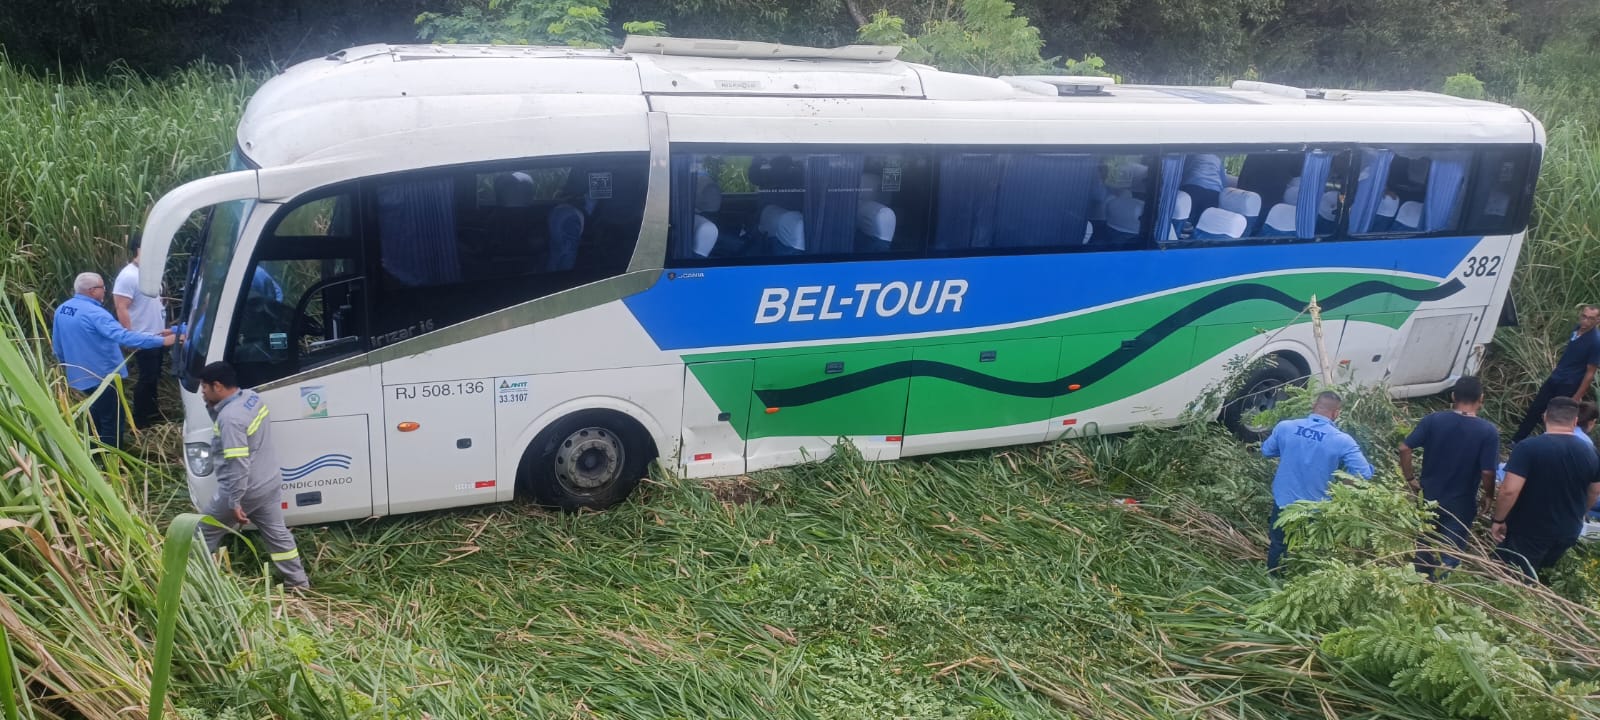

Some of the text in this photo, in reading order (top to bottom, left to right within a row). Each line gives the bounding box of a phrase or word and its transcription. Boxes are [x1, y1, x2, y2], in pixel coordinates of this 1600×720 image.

[1463, 255, 1501, 277] 382
[754, 279, 969, 324] BEL-TOUR
[395, 381, 484, 400] RJ 508.136
[499, 393, 529, 404] 33.3107
[1293, 425, 1327, 442] ICN
[281, 476, 353, 491] ONDICIONADO
